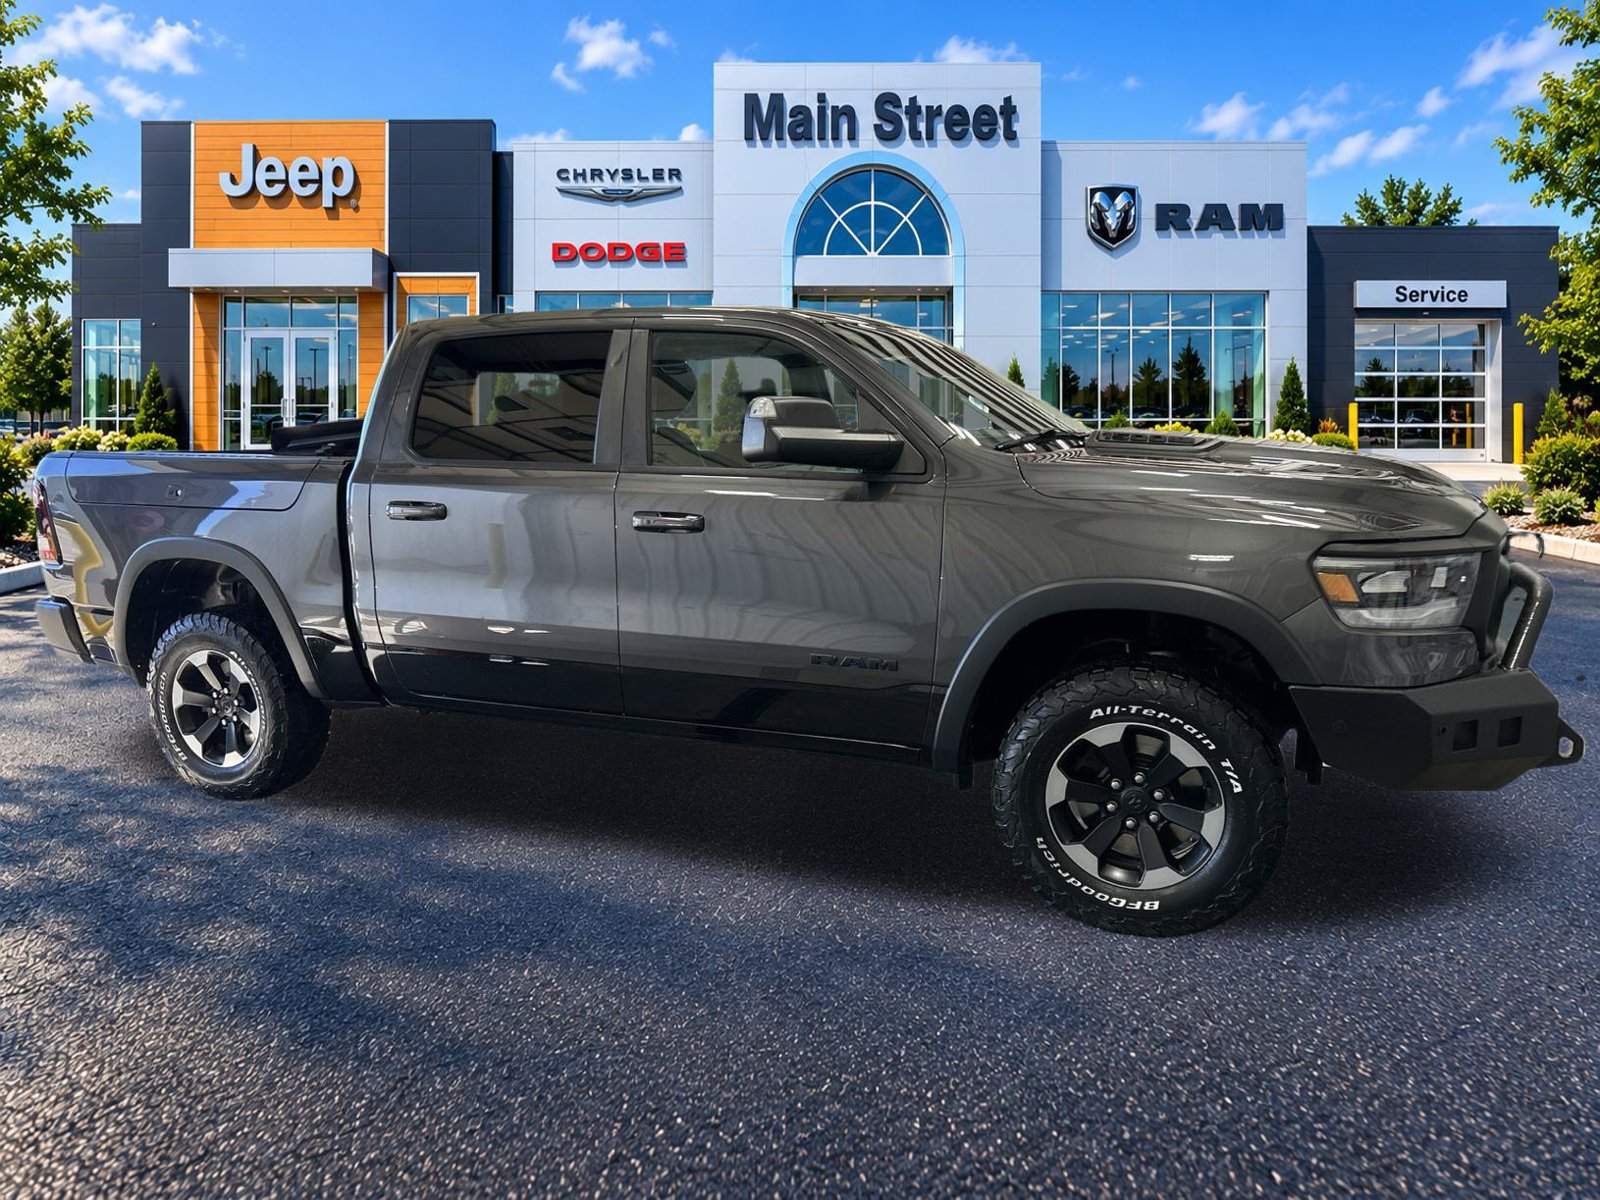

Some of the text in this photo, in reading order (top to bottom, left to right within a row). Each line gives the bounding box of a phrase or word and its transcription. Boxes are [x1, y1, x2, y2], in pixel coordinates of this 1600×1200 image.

[744, 91, 1018, 142] Main Street
[219, 143, 355, 208] Jeep
[556, 168, 683, 182] CHRYSLER
[1155, 203, 1284, 232] RAM
[551, 242, 687, 263] DODGE
[1395, 285, 1468, 303] Service
[810, 653, 898, 671] RAM
[1089, 705, 1243, 794] All-Terrain T/A
[1036, 837, 1160, 911] BFGoodrich
